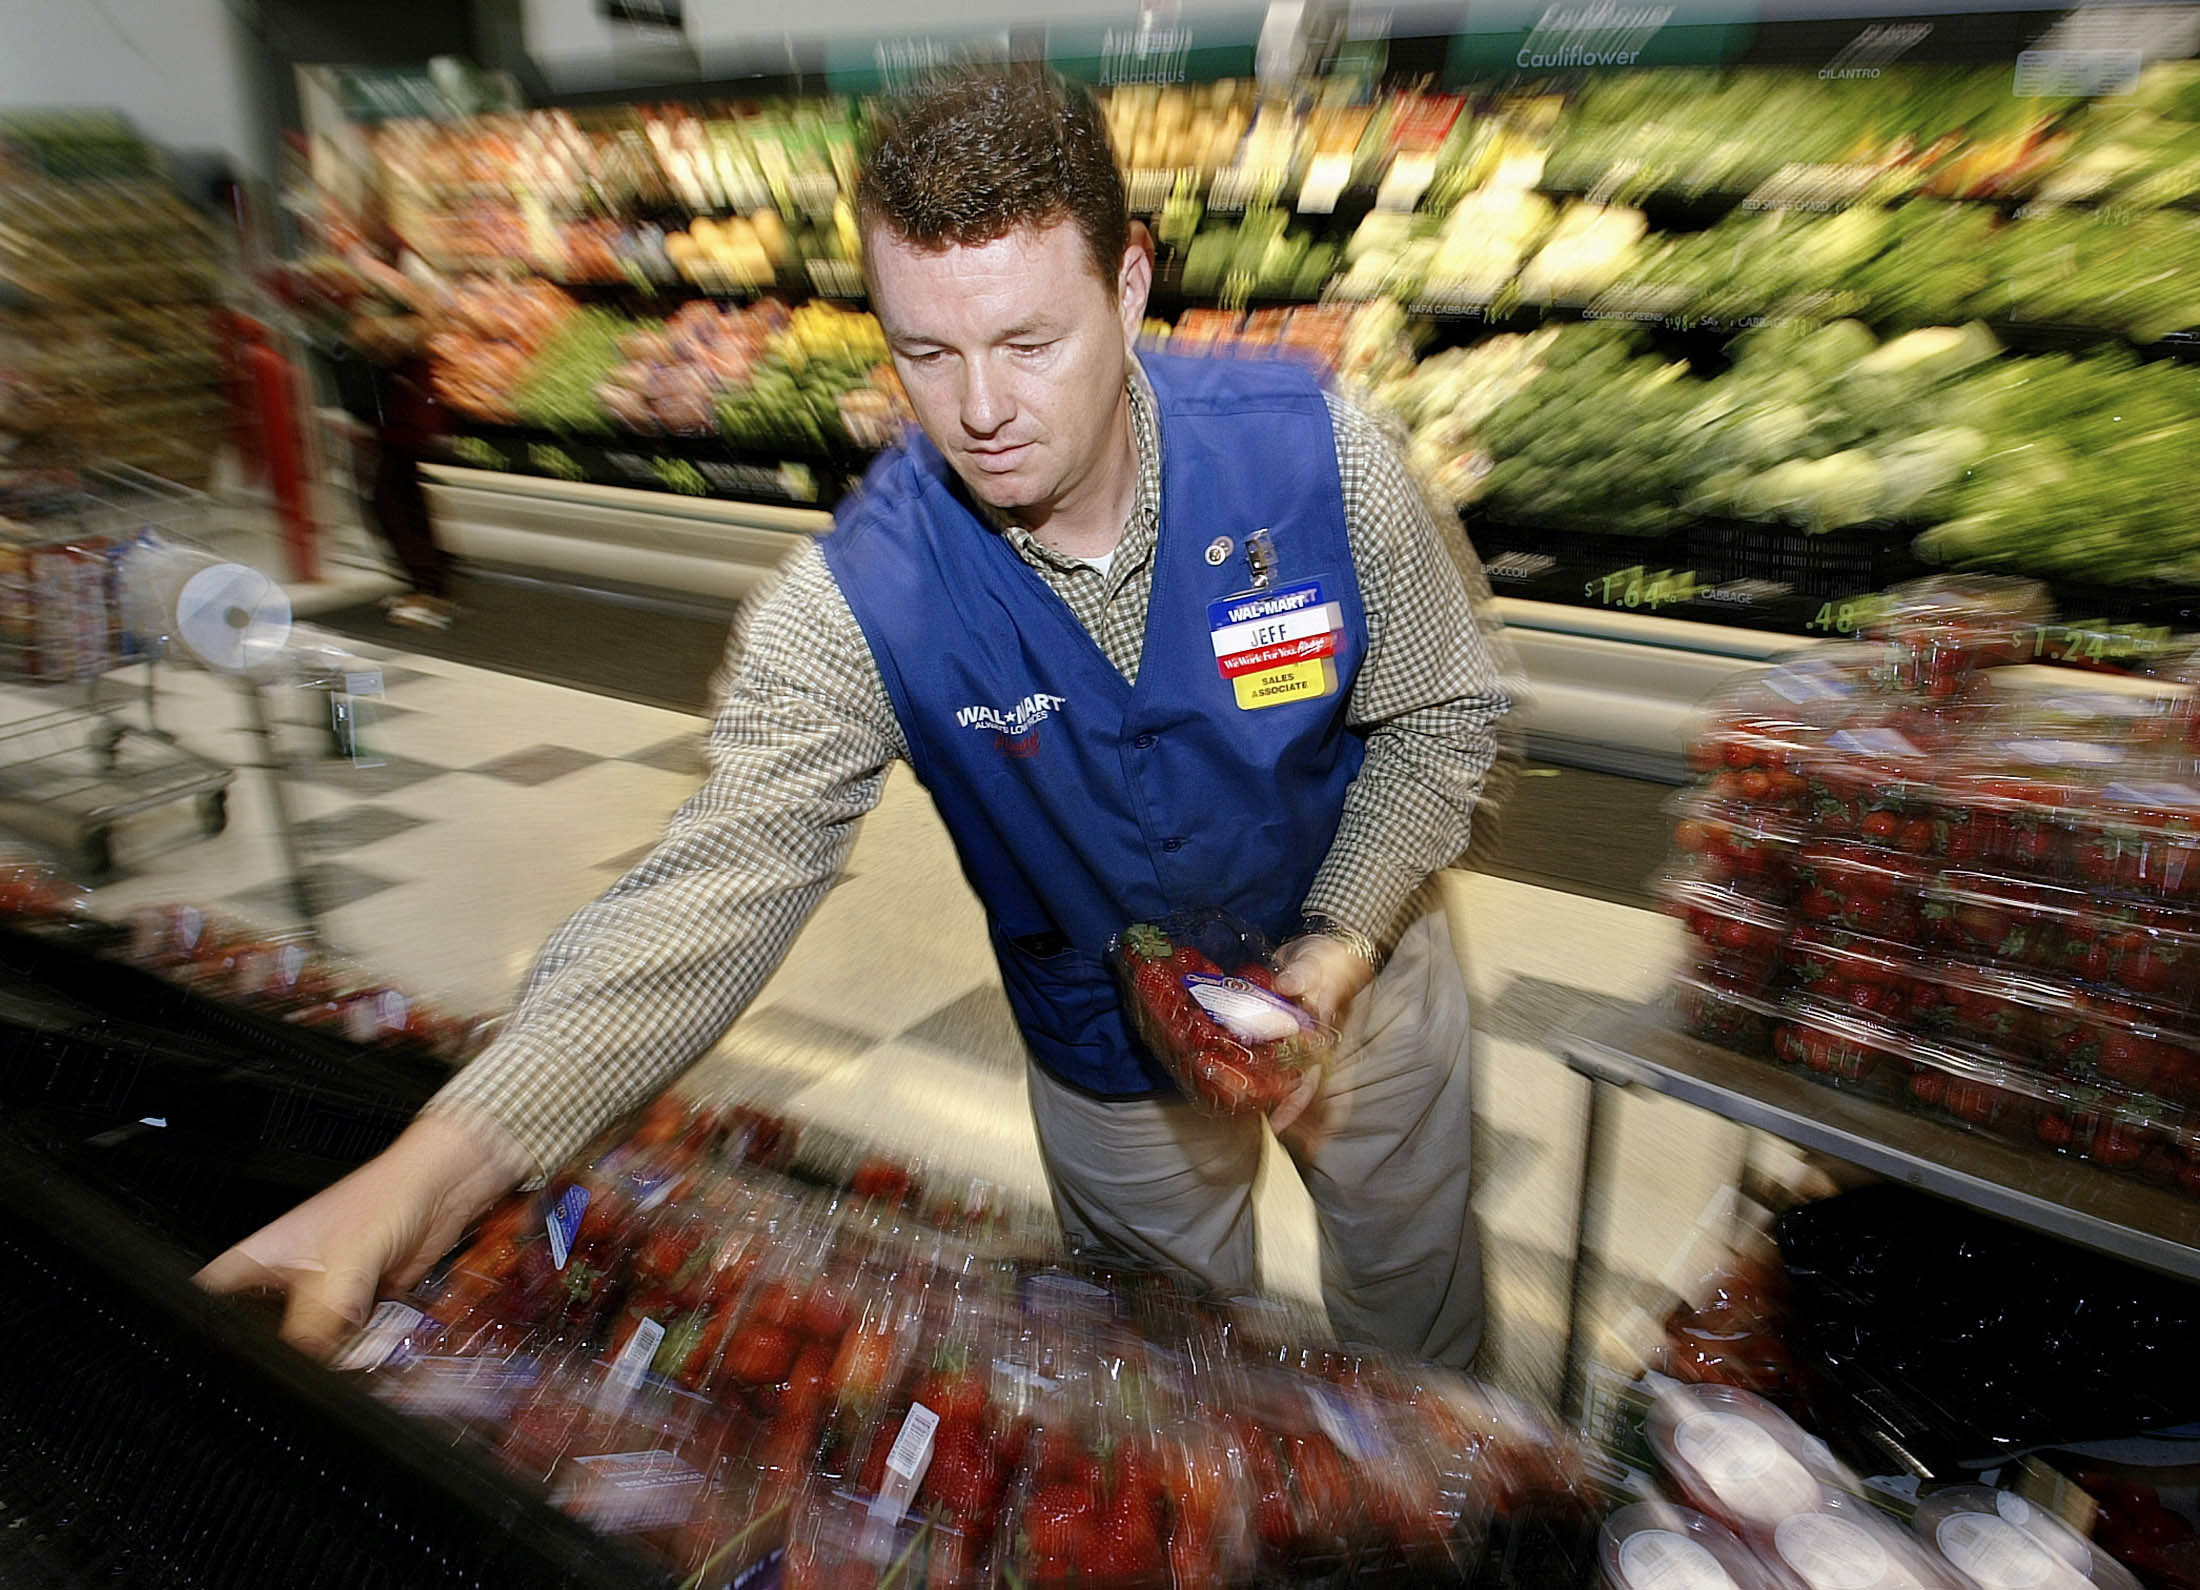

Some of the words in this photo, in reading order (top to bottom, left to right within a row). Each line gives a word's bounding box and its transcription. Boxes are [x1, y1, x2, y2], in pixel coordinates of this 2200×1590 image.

[1516, 46, 1640, 68] Cauliflower
[1098, 70, 1185, 89] Asparagus
[1818, 68, 1881, 80] CILANTRO
[1434, 305, 1481, 316] CABBAGE
[1582, 310, 1624, 320] COLLARD
[1625, 311, 1665, 322] GREENS
[1480, 563, 1528, 579] BROCCOLI
[1701, 588, 1752, 604] CABBAGE
[1250, 623, 1287, 647] JEFF
[1262, 650, 1278, 662] For
[1261, 672, 1295, 686] SALES
[1251, 680, 1308, 698] ASSOCIATE
